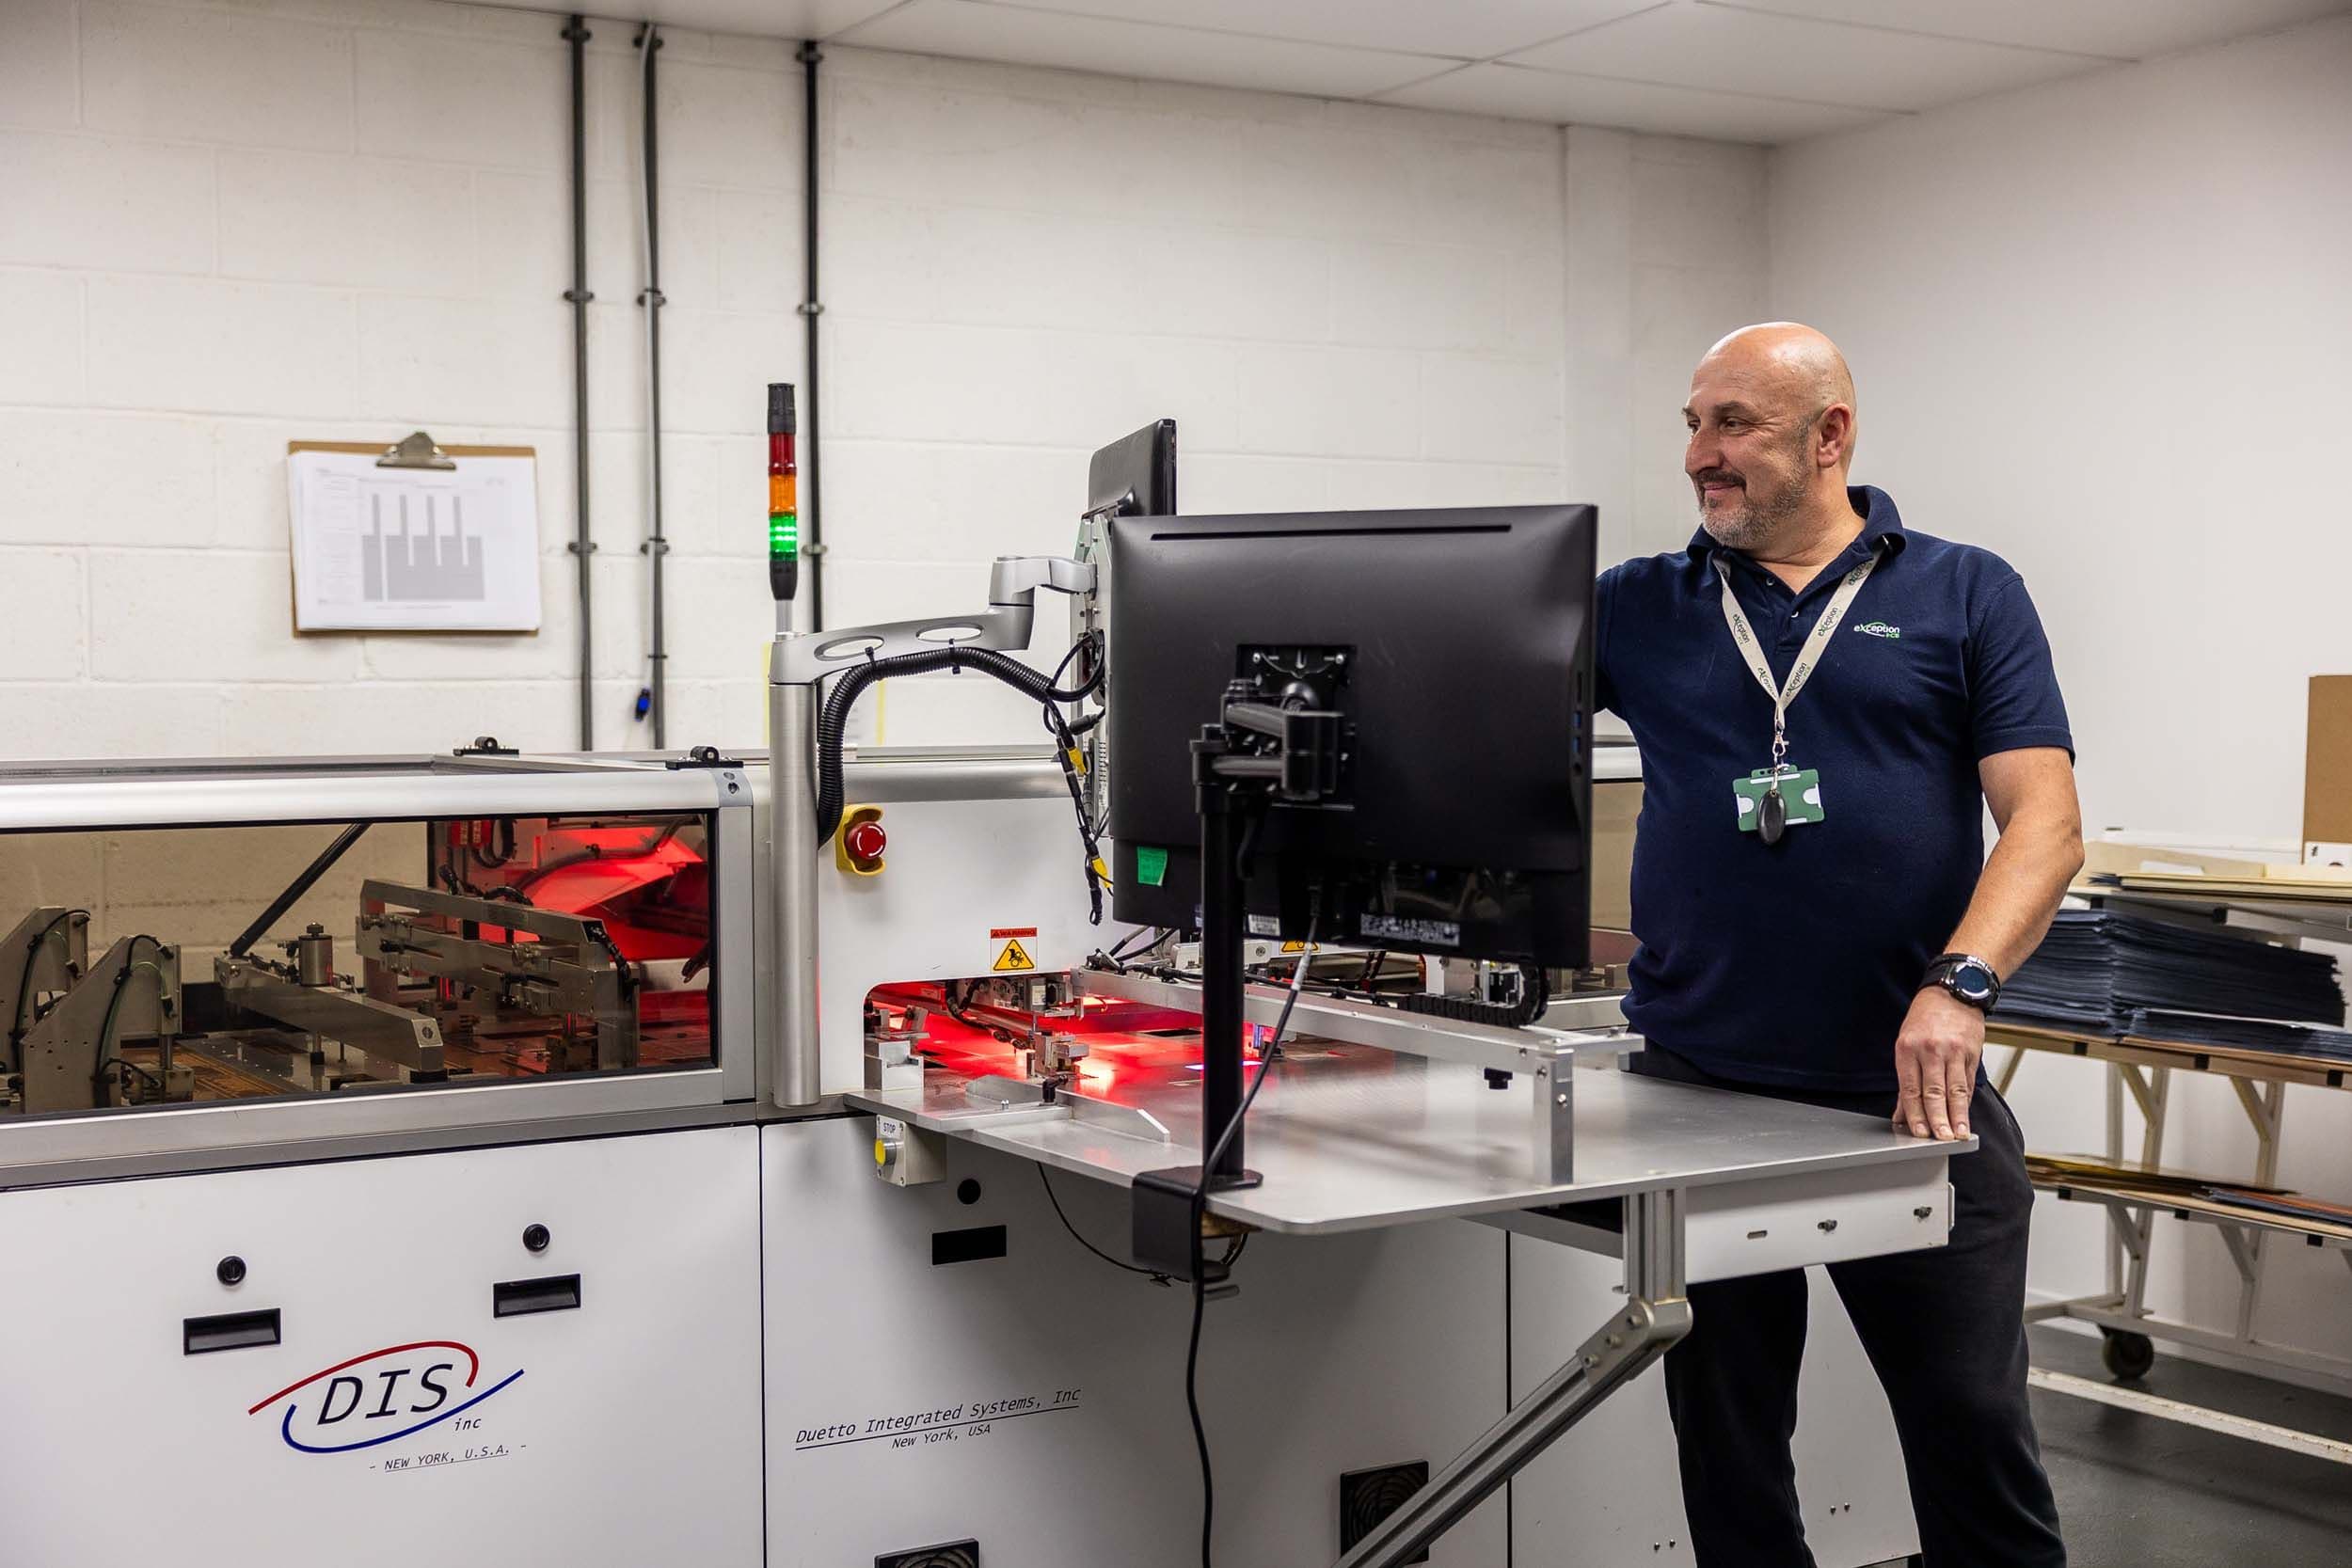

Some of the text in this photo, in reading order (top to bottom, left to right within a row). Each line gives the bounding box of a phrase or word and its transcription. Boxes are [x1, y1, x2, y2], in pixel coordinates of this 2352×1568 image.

[883, 1122, 897, 1134] STOP
[317, 1363, 453, 1426] DIS
[454, 1417, 482, 1432] inc
[795, 1388, 1081, 1444] Duetto Integrated Systems, Inc
[891, 1424, 992, 1449] New York, USA
[384, 1458, 410, 1470] NEW
[418, 1451, 454, 1465] YORK,
[465, 1444, 510, 1459] U.S.A.
